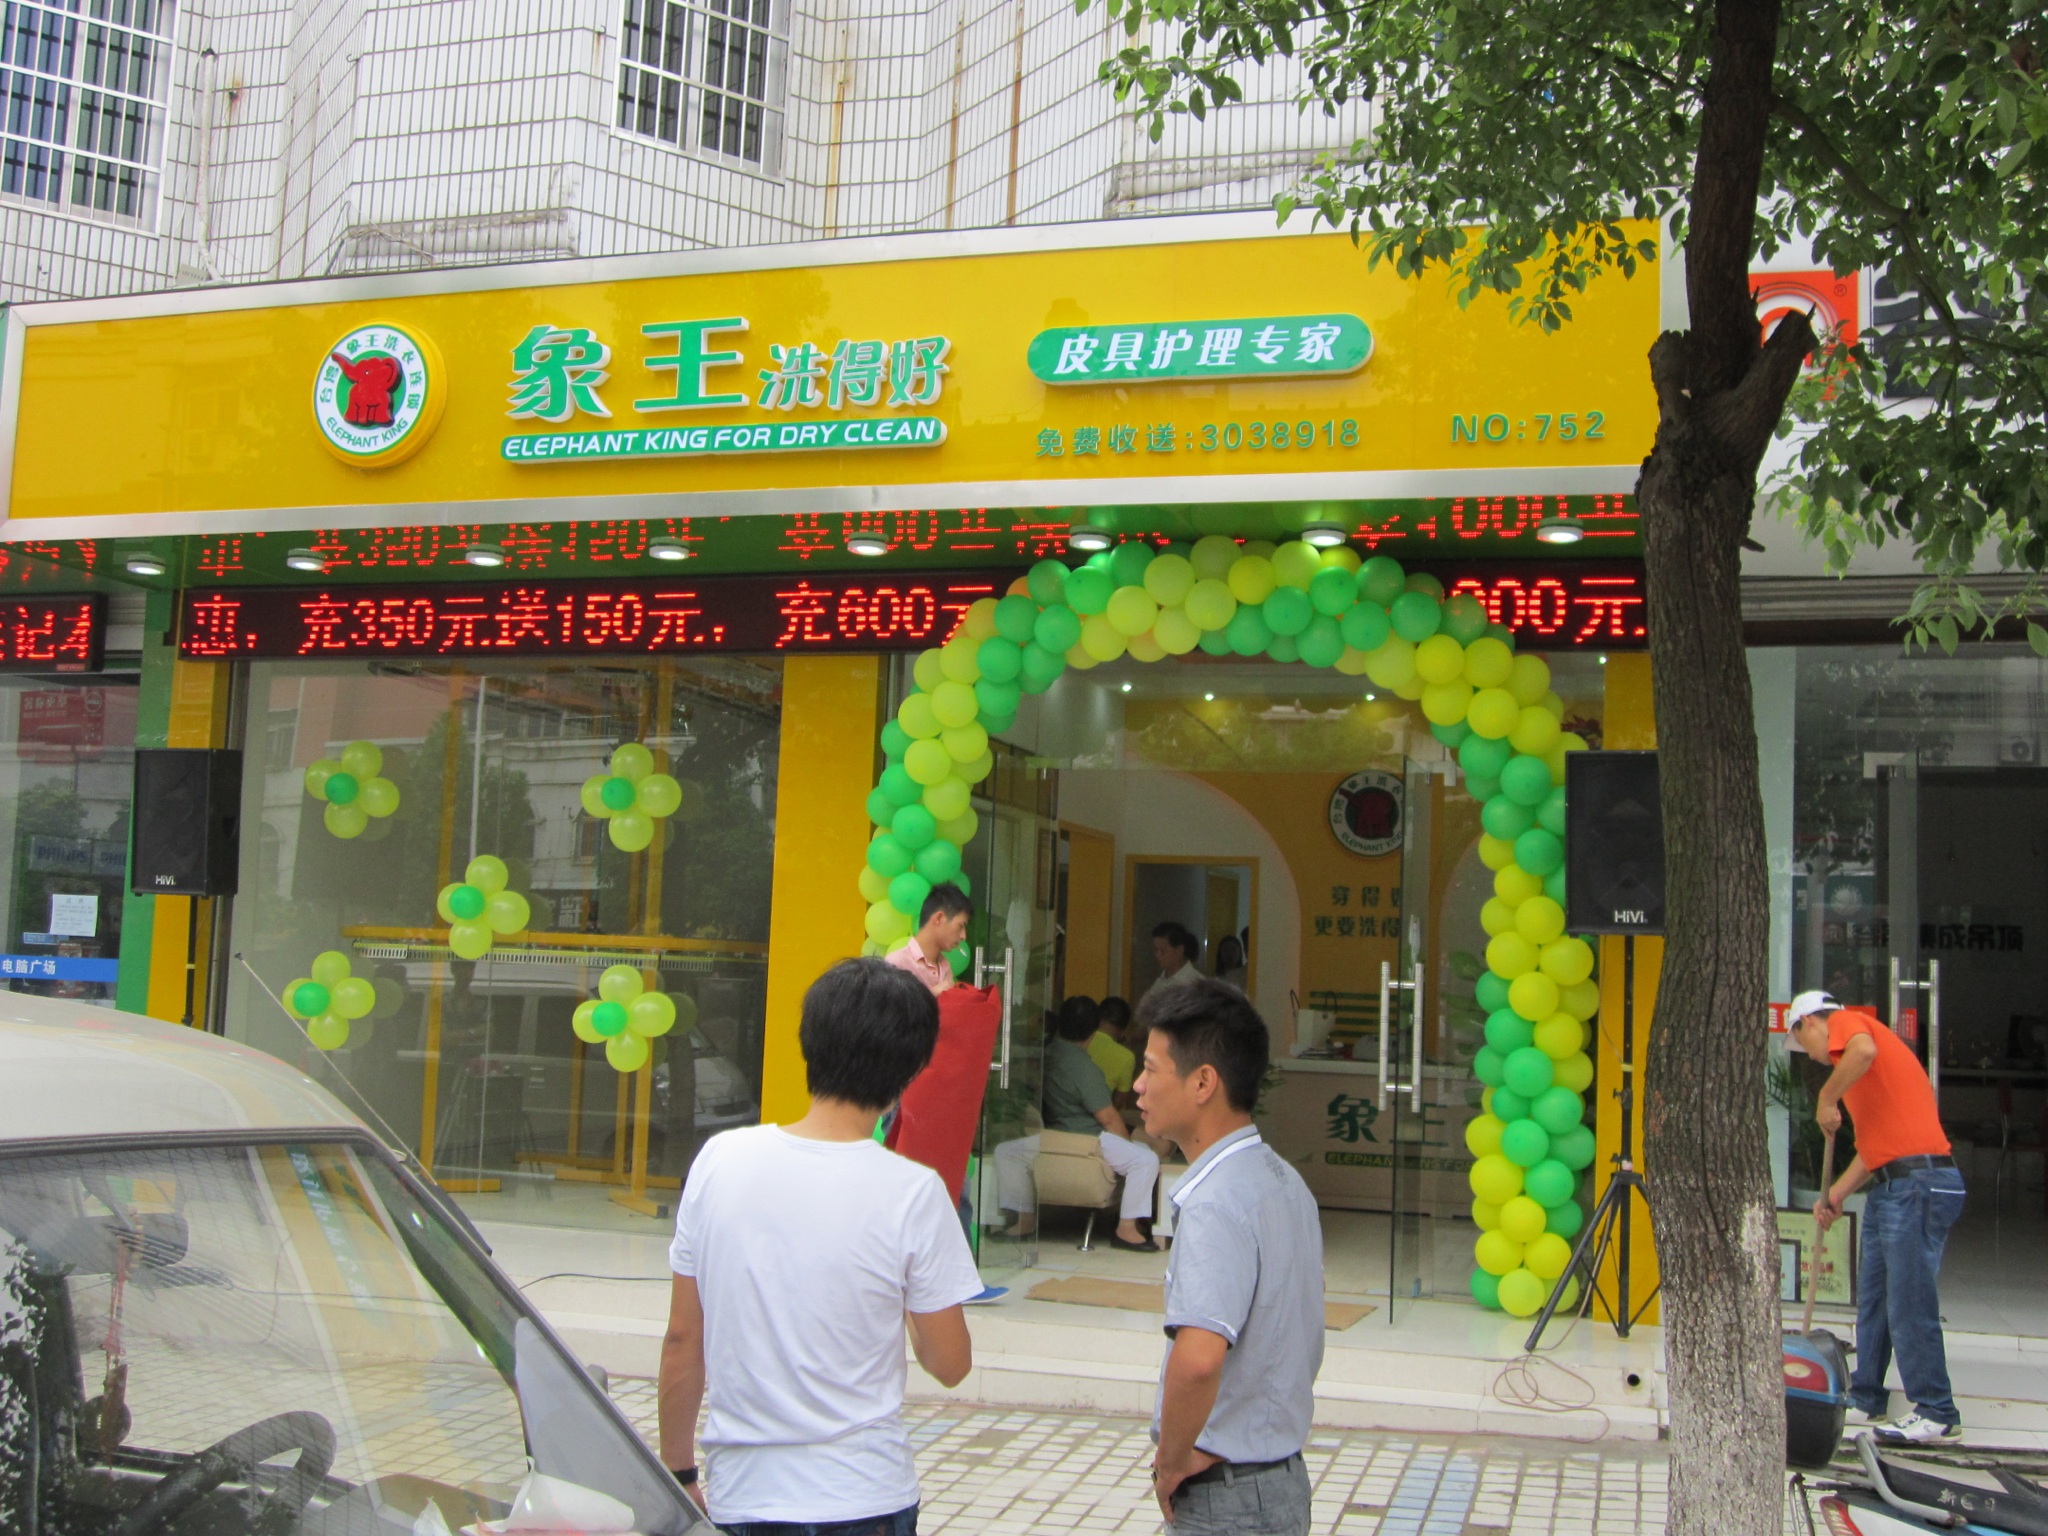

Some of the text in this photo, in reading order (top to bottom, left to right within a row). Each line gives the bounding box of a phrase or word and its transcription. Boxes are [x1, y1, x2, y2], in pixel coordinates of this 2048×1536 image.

[1052, 321, 1342, 375] 皮具护理专家
[325, 416, 408, 448] ELEPHANT KING
[505, 419, 936, 457] ELEPHANT KING FOR DRY CLEAN
[1451, 410, 1605, 443] NO:752
[155, 874, 176, 886] HiVi
[1614, 909, 1645, 924] HiVi
[2, 958, 57, 976] 电脑广场
[1328, 1152, 1400, 1168] ELEPHAN
